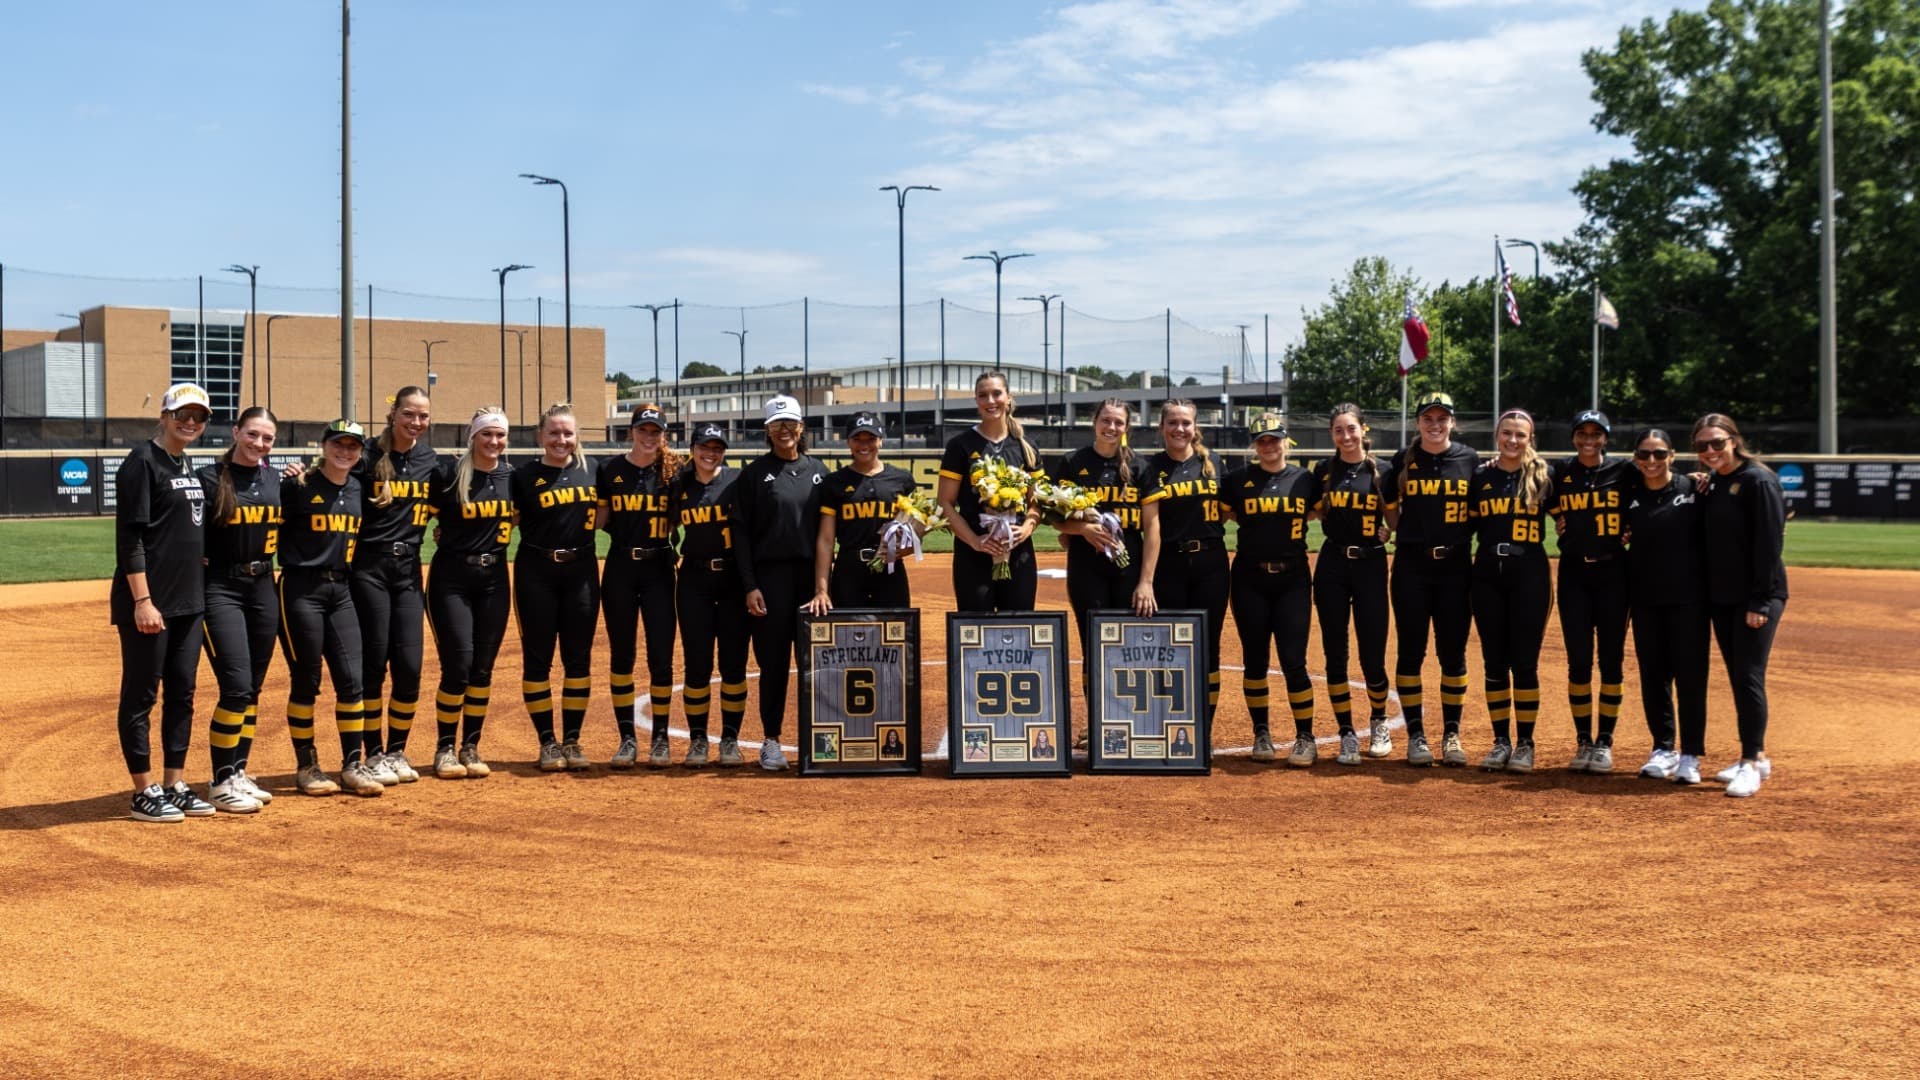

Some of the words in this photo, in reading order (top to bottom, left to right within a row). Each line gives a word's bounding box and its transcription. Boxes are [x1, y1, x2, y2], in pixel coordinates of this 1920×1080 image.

[63, 471, 88, 479] NCAA
[57, 486, 92, 495] DIVISION
[538, 486, 598, 509] OWLS
[1405, 479, 1469, 496] OWLS
[611, 494, 668, 512] OWLS
[1202, 500, 1220, 522] 18
[1244, 497, 1306, 515] OWLS
[1559, 490, 1620, 511] OWLS
[584, 507, 597, 531] 3
[1444, 501, 1468, 523] 22
[496, 521, 512, 544] 3
[648, 516, 668, 539] 10
[1290, 518, 1304, 540] 2
[1362, 515, 1376, 537] 5
[1511, 519, 1540, 543] 66
[1595, 513, 1620, 537] 19
[264, 529, 279, 555] 2
[721, 527, 732, 549] 1
[821, 646, 899, 666] STRICKLAND
[982, 648, 1034, 665] TYSON
[1121, 646, 1176, 664] HOWES
[843, 667, 877, 717] 6
[975, 670, 1043, 717] 99
[1112, 667, 1187, 714] 44
